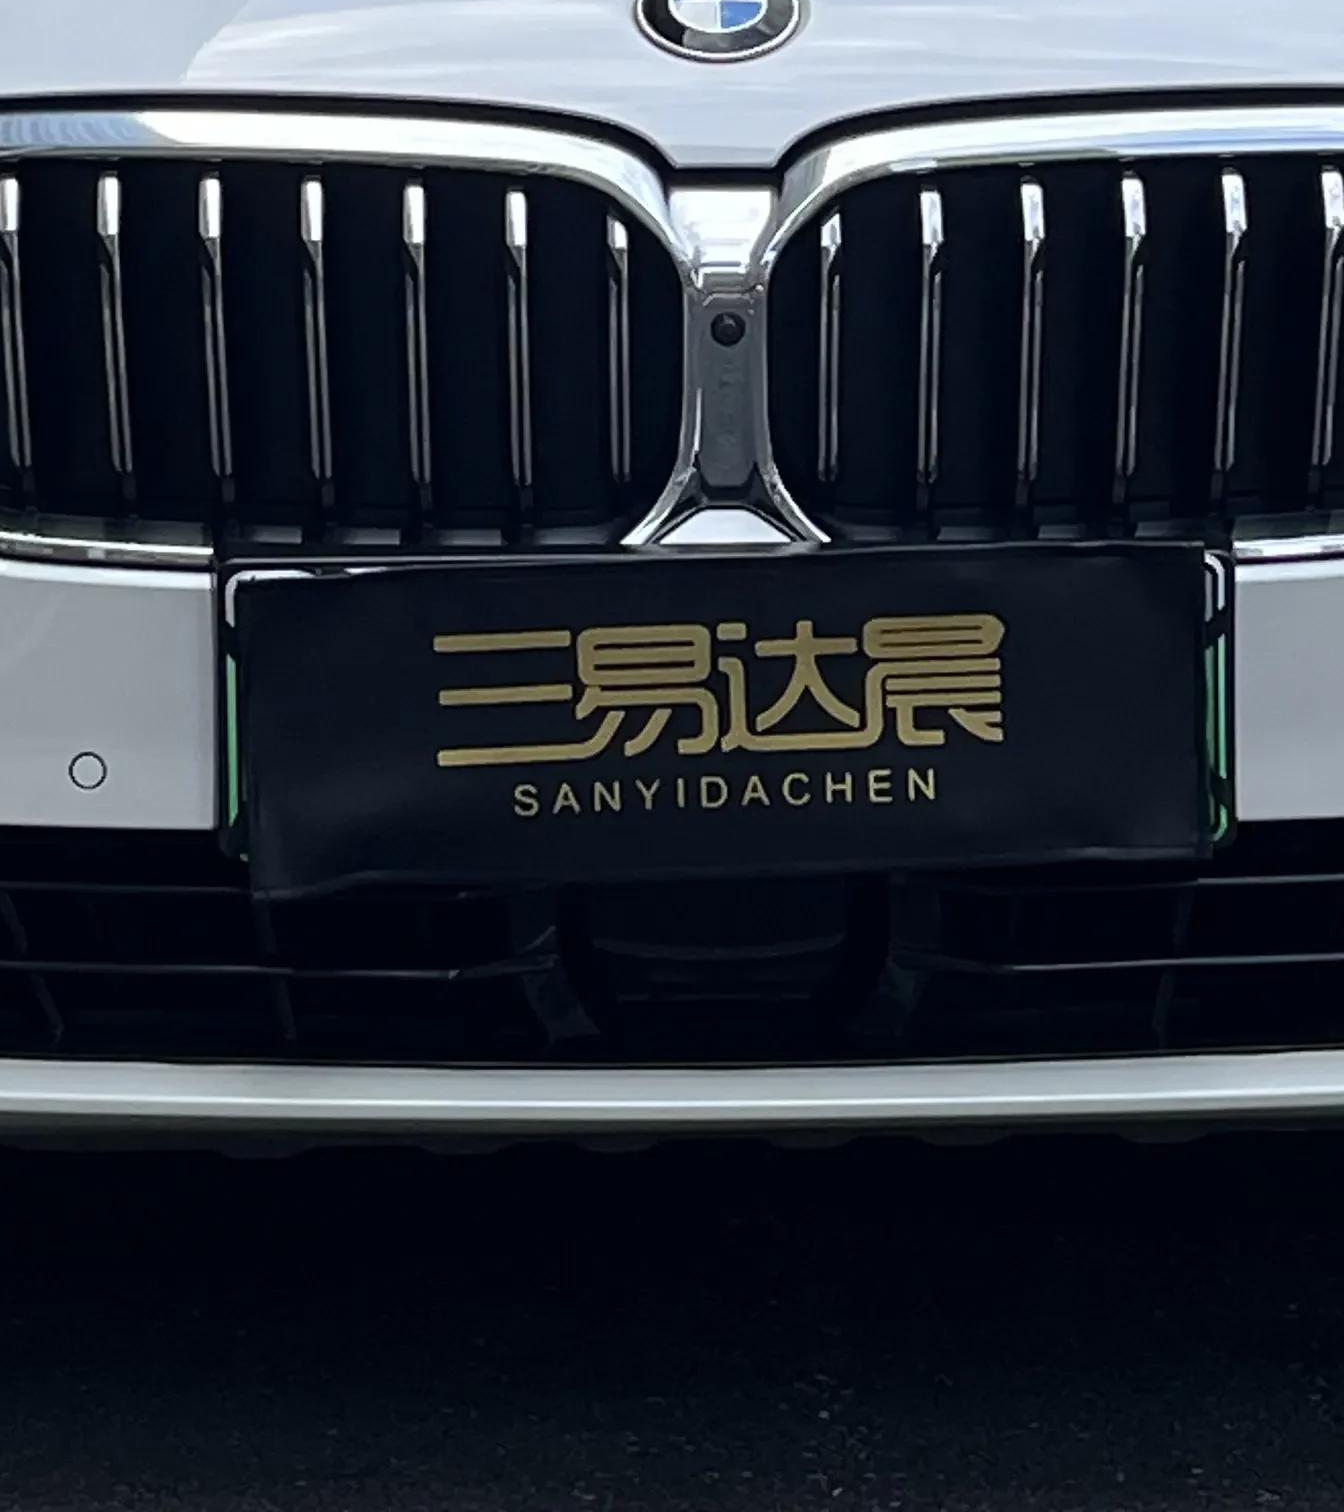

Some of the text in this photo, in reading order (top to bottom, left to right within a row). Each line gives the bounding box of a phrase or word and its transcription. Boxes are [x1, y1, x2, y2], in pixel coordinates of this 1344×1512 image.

[433, 613, 1005, 767] 三易达晨
[514, 768, 940, 819] SANYIDACHEN
